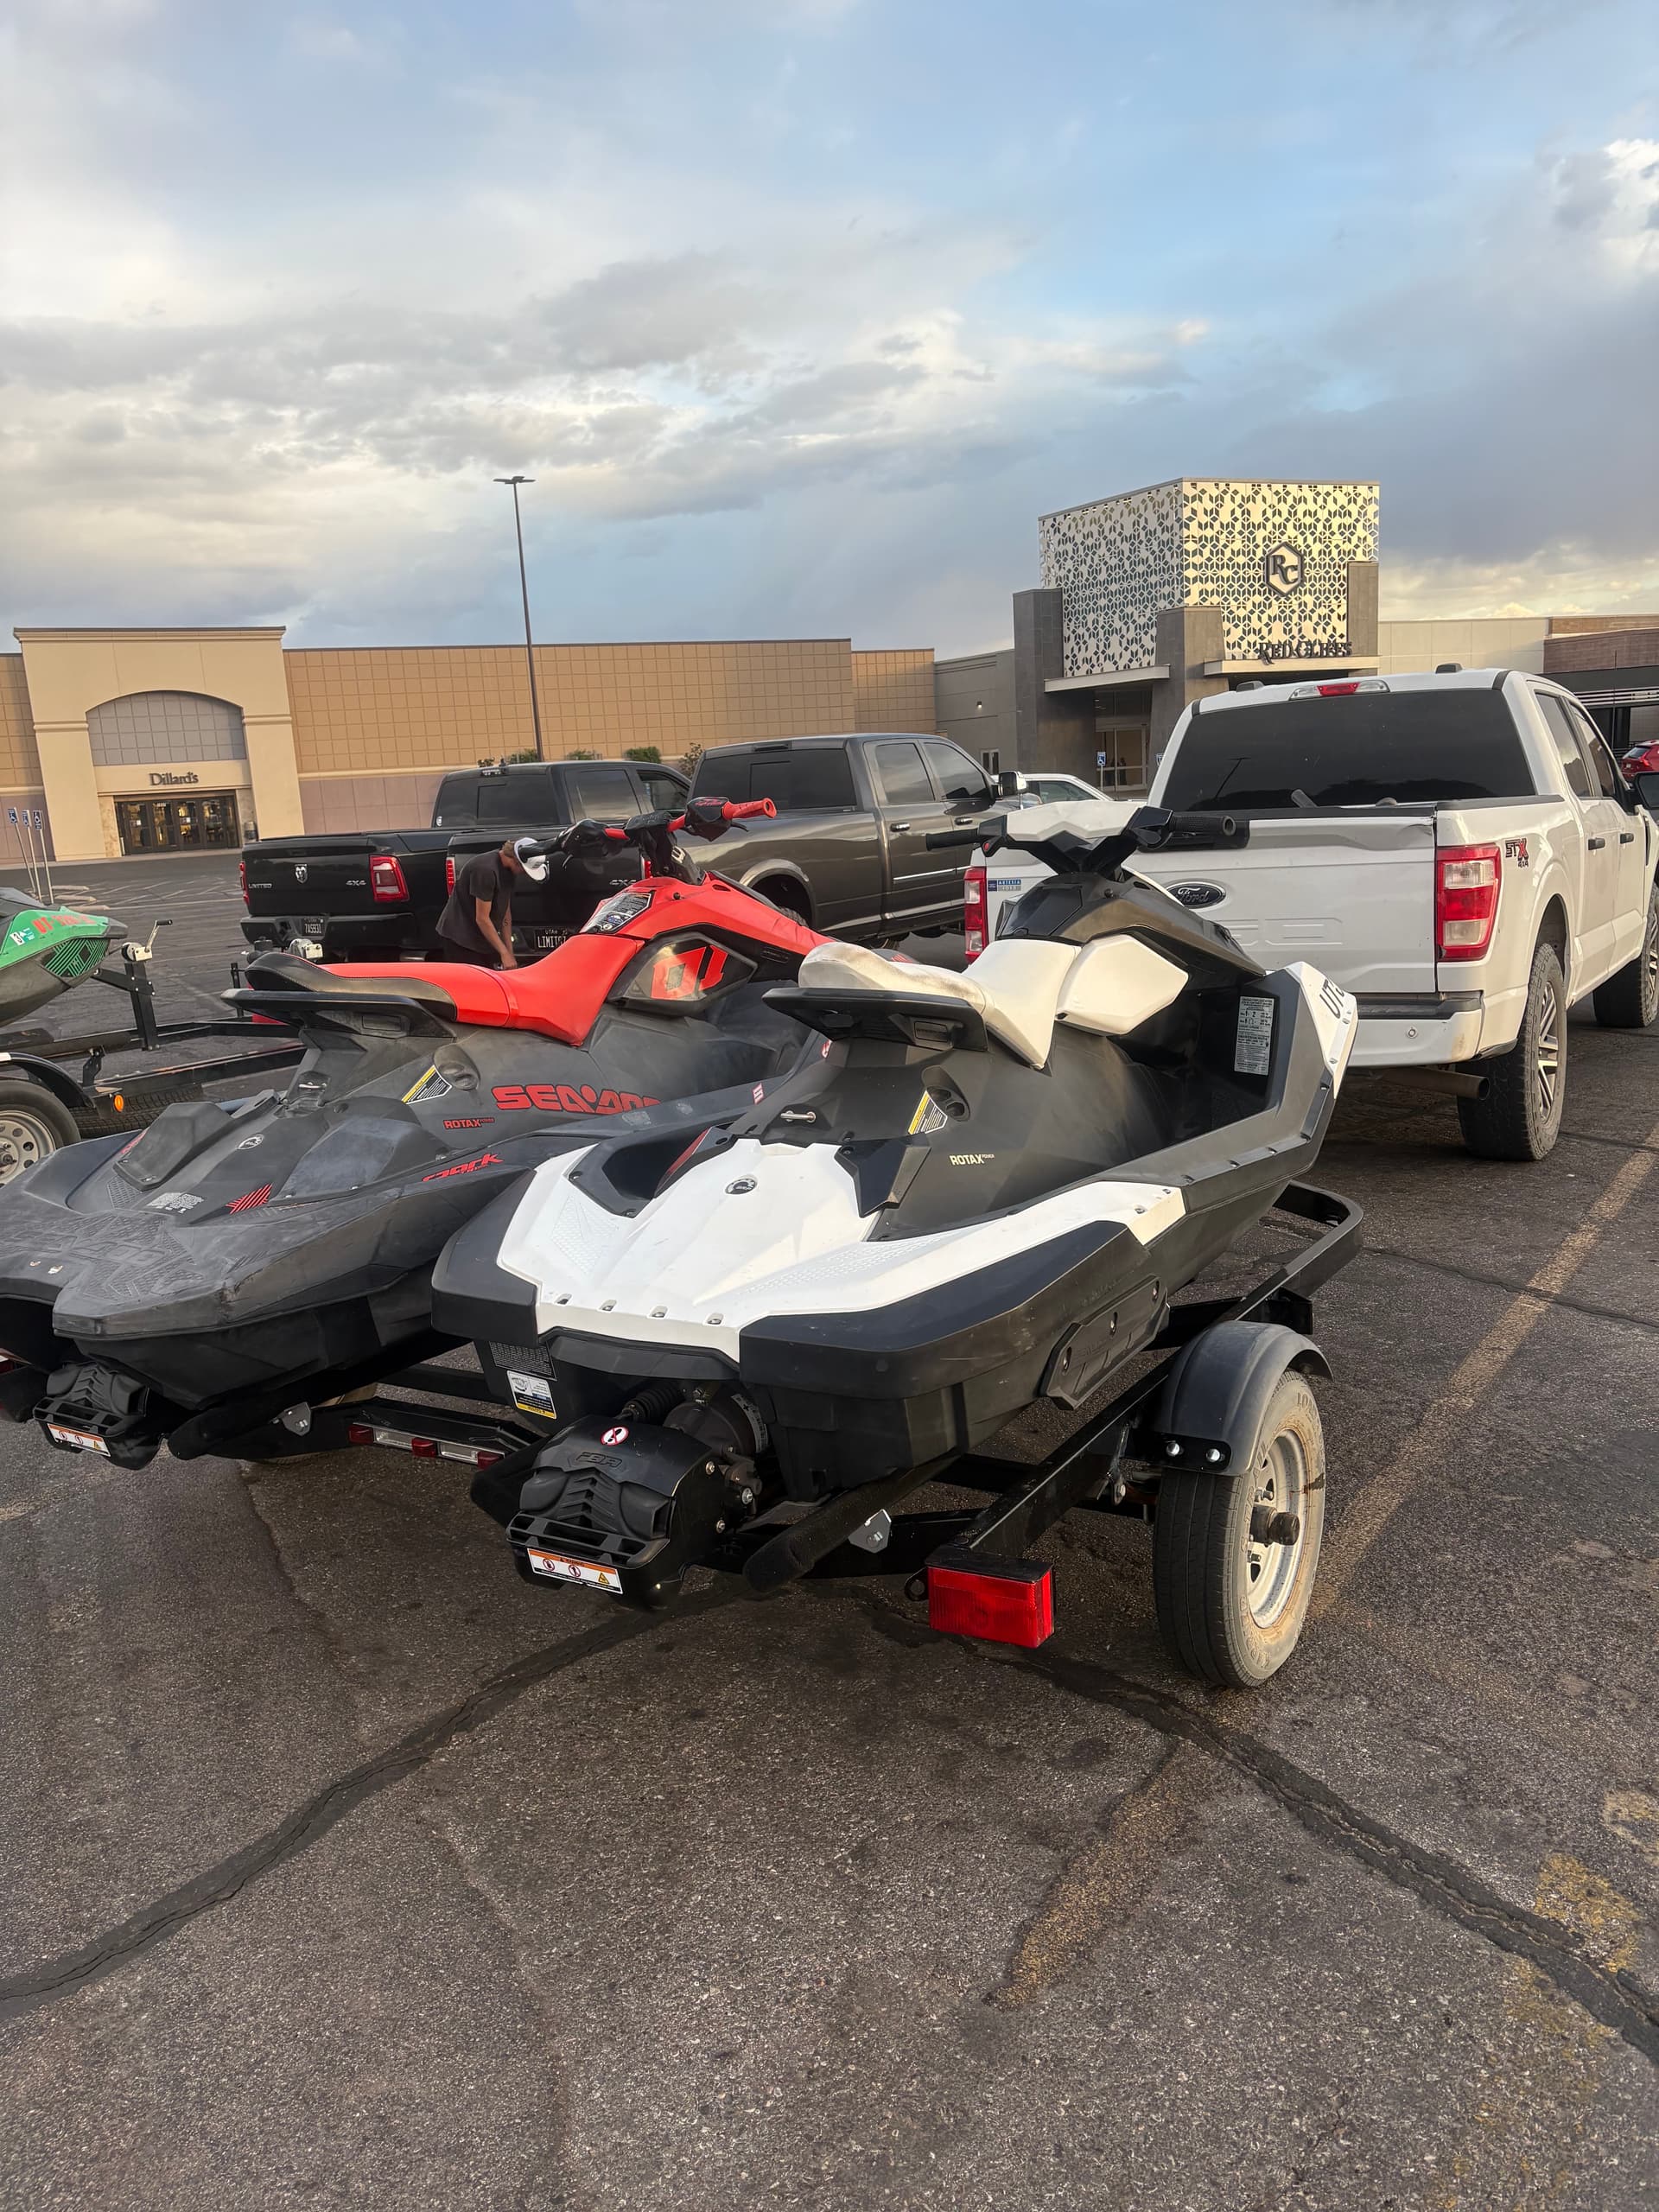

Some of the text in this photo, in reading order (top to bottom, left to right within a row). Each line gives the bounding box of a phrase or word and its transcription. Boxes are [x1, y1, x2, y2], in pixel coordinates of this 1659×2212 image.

[149, 772, 199, 785] Dillard's
[1177, 887, 1210, 903] Ford
[443, 1119, 481, 1130] ROTAX
[950, 1154, 985, 1166] ROTAX
